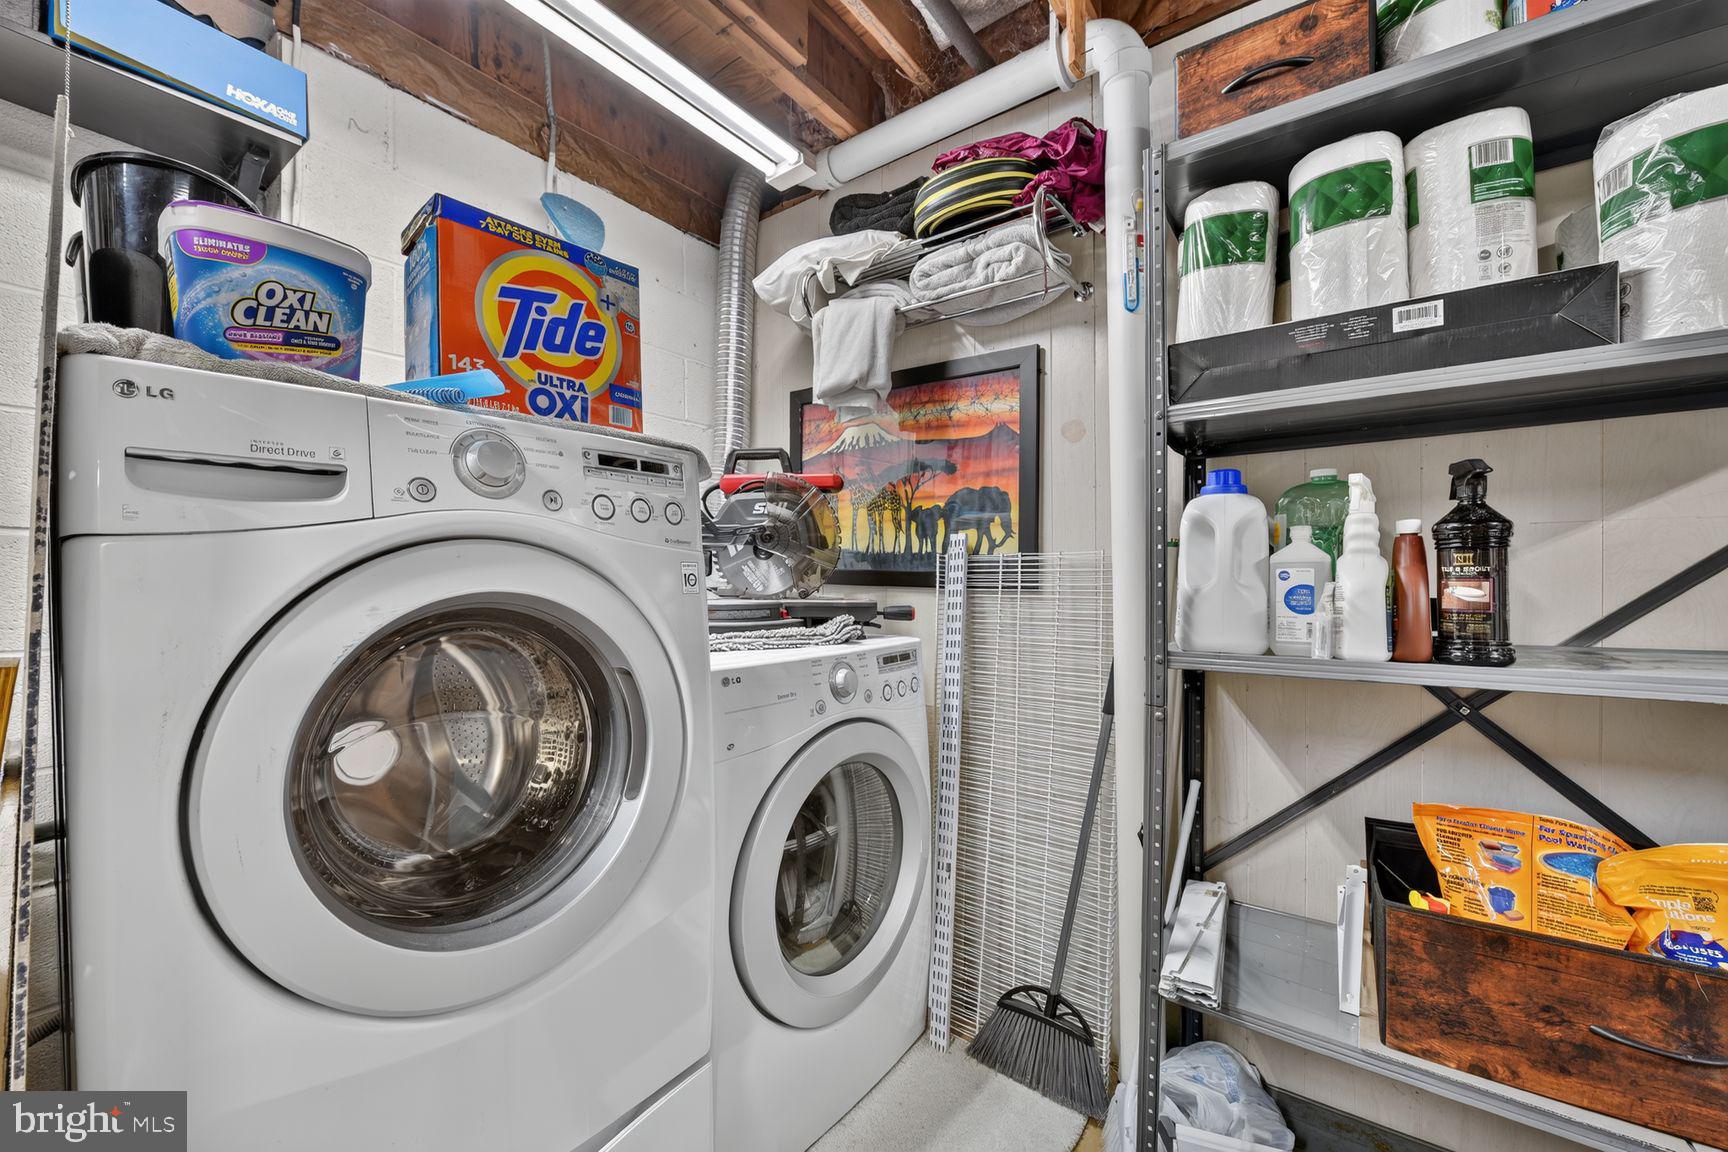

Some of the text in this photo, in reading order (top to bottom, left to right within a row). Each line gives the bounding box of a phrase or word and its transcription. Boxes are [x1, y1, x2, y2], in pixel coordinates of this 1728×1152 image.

[226, 83, 279, 118] HOKA
[255, 280, 316, 311] OXI
[231, 297, 333, 335] CLEAN
[497, 284, 608, 362] Tide
[146, 385, 175, 401] LG
[536, 370, 588, 396] ULTRA
[526, 386, 590, 424] OXI
[250, 443, 316, 459] Direct Drive
[1538, 825, 1555, 834] For
[1538, 834, 1597, 854] Pool Water
